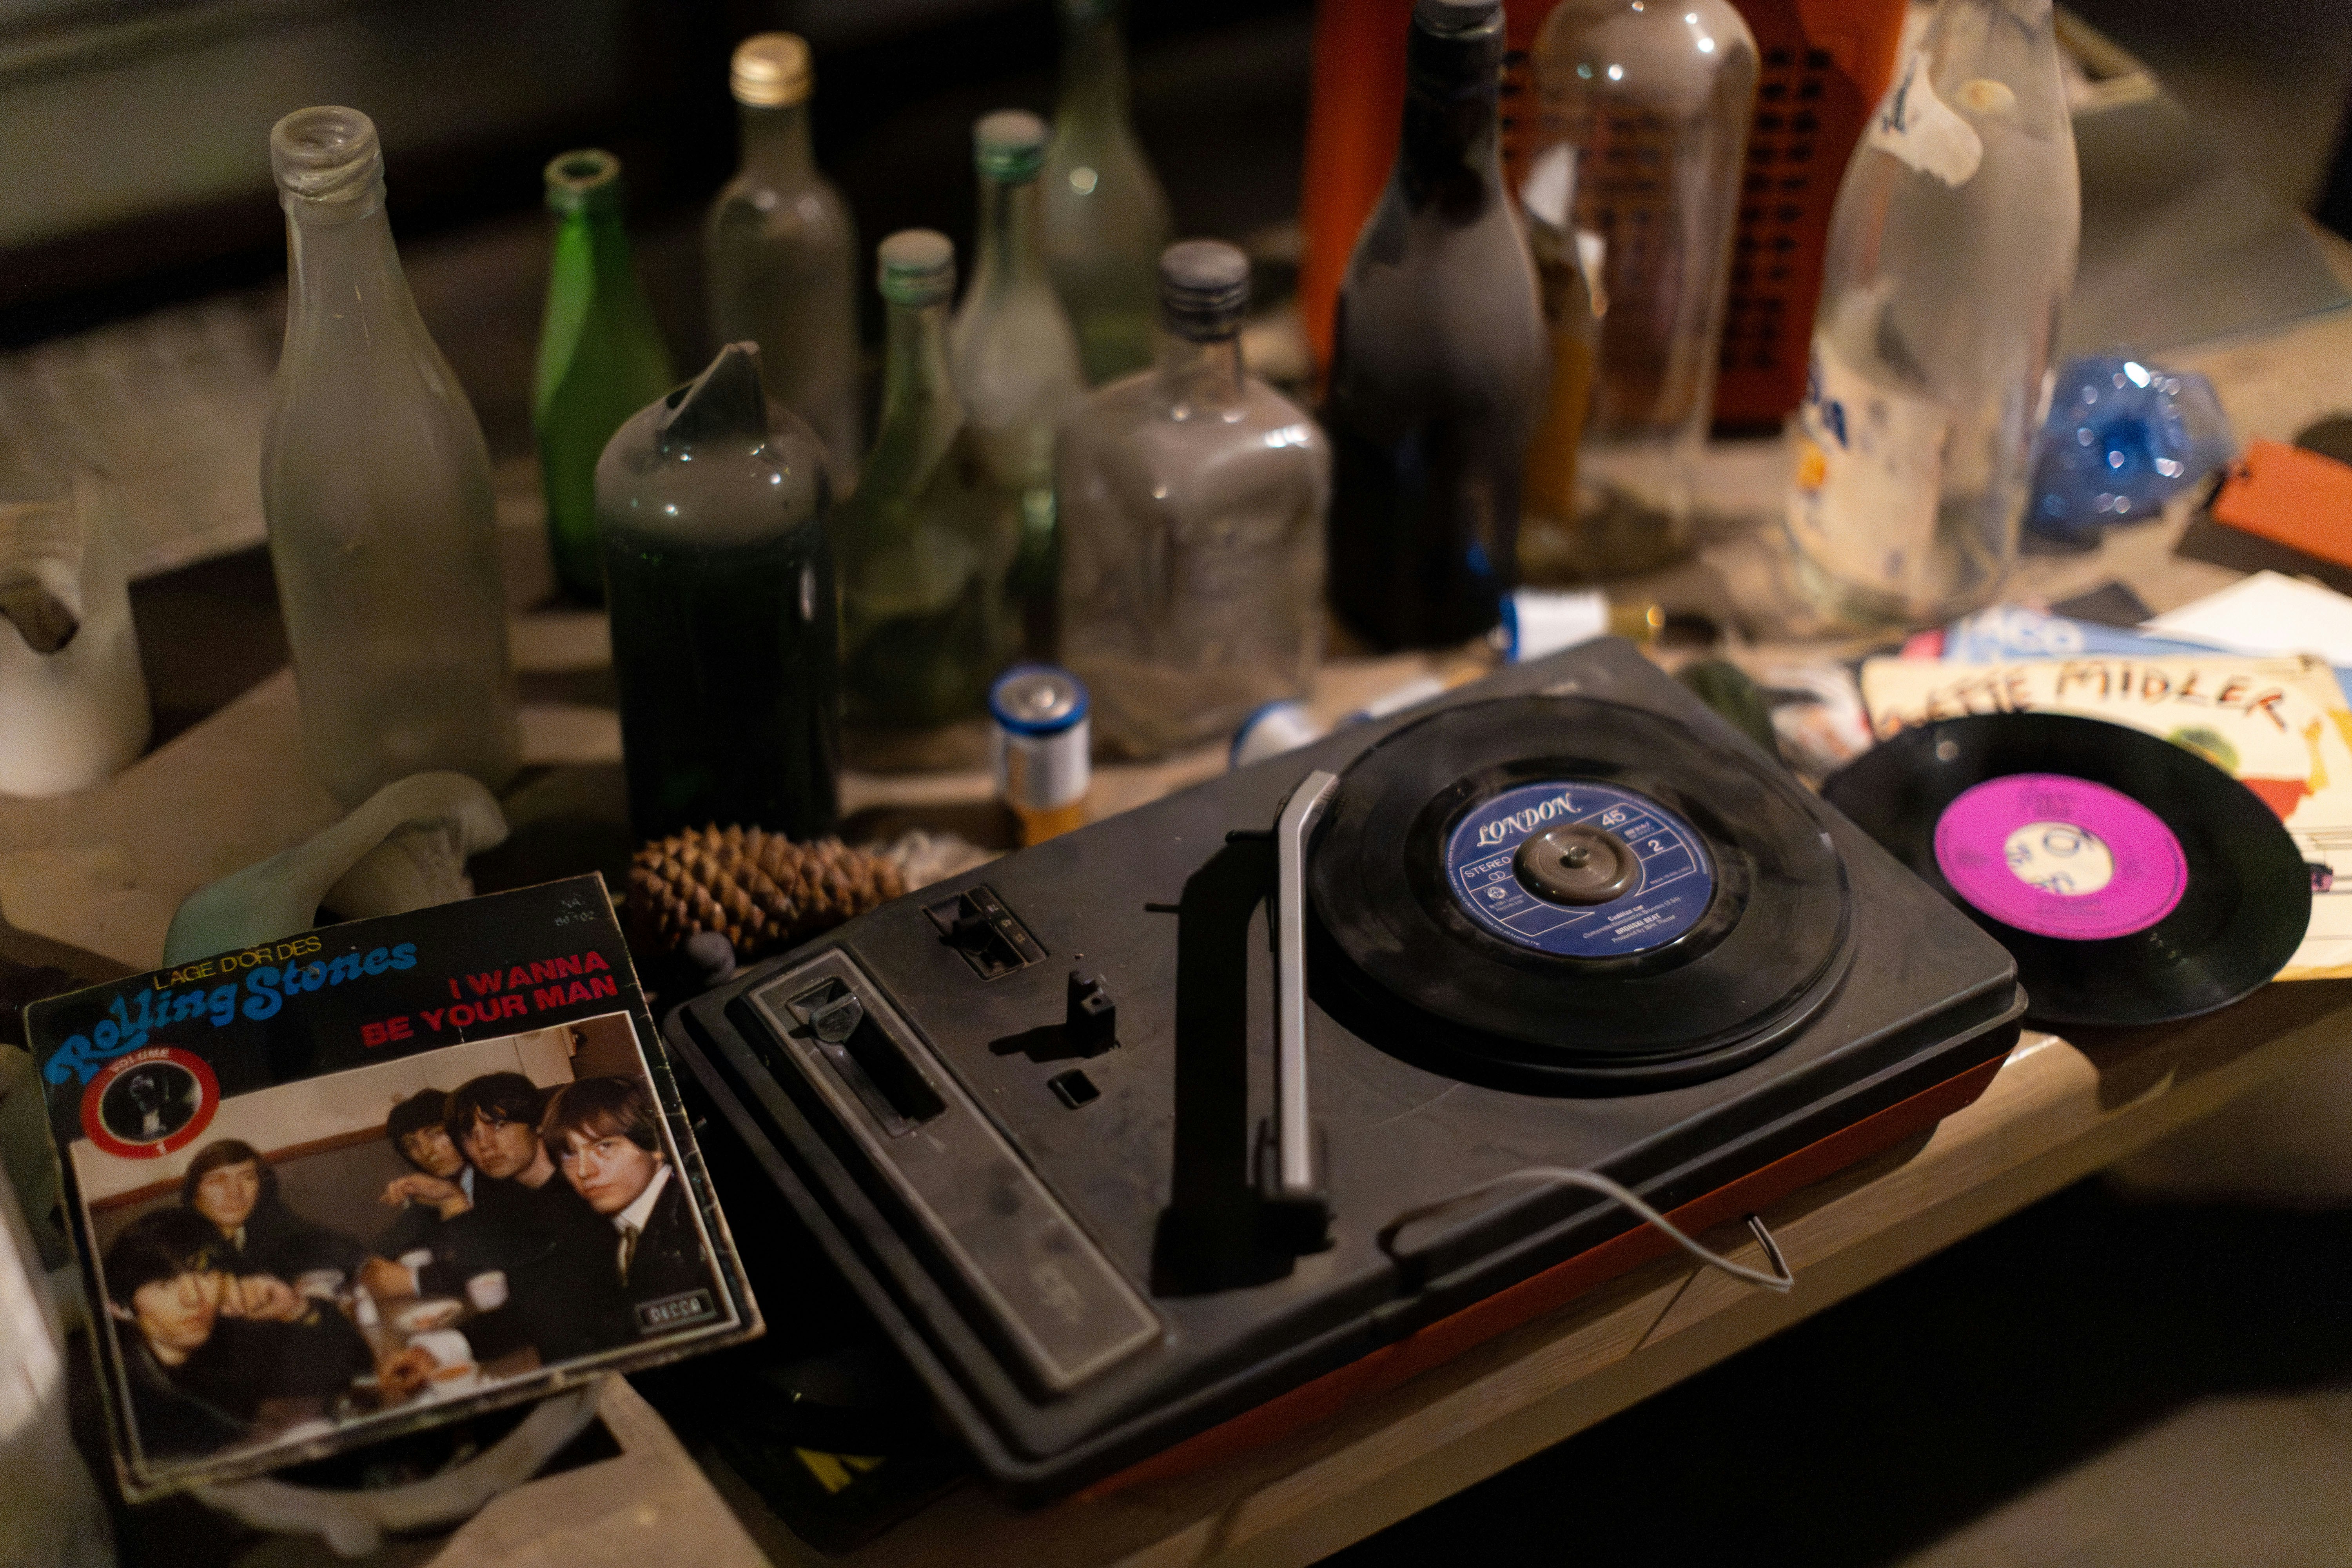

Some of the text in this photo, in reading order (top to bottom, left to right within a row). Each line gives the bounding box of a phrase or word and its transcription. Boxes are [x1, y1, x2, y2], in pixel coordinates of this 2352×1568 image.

[1477, 792, 1581, 846] LONDON
[1602, 809, 1626, 825] 45
[1648, 840, 1663, 851] 2
[1465, 857, 1512, 877] STEREO
[1615, 920, 1644, 935] BRONSKI
[1643, 913, 1661, 923] BEAT
[278, 936, 321, 960] DES
[449, 951, 610, 999] I WANNA
[43, 942, 417, 1085] Rolling Stones
[360, 975, 618, 1048] BE YOUR MAN
[108, 1047, 170, 1073] VOLUME
